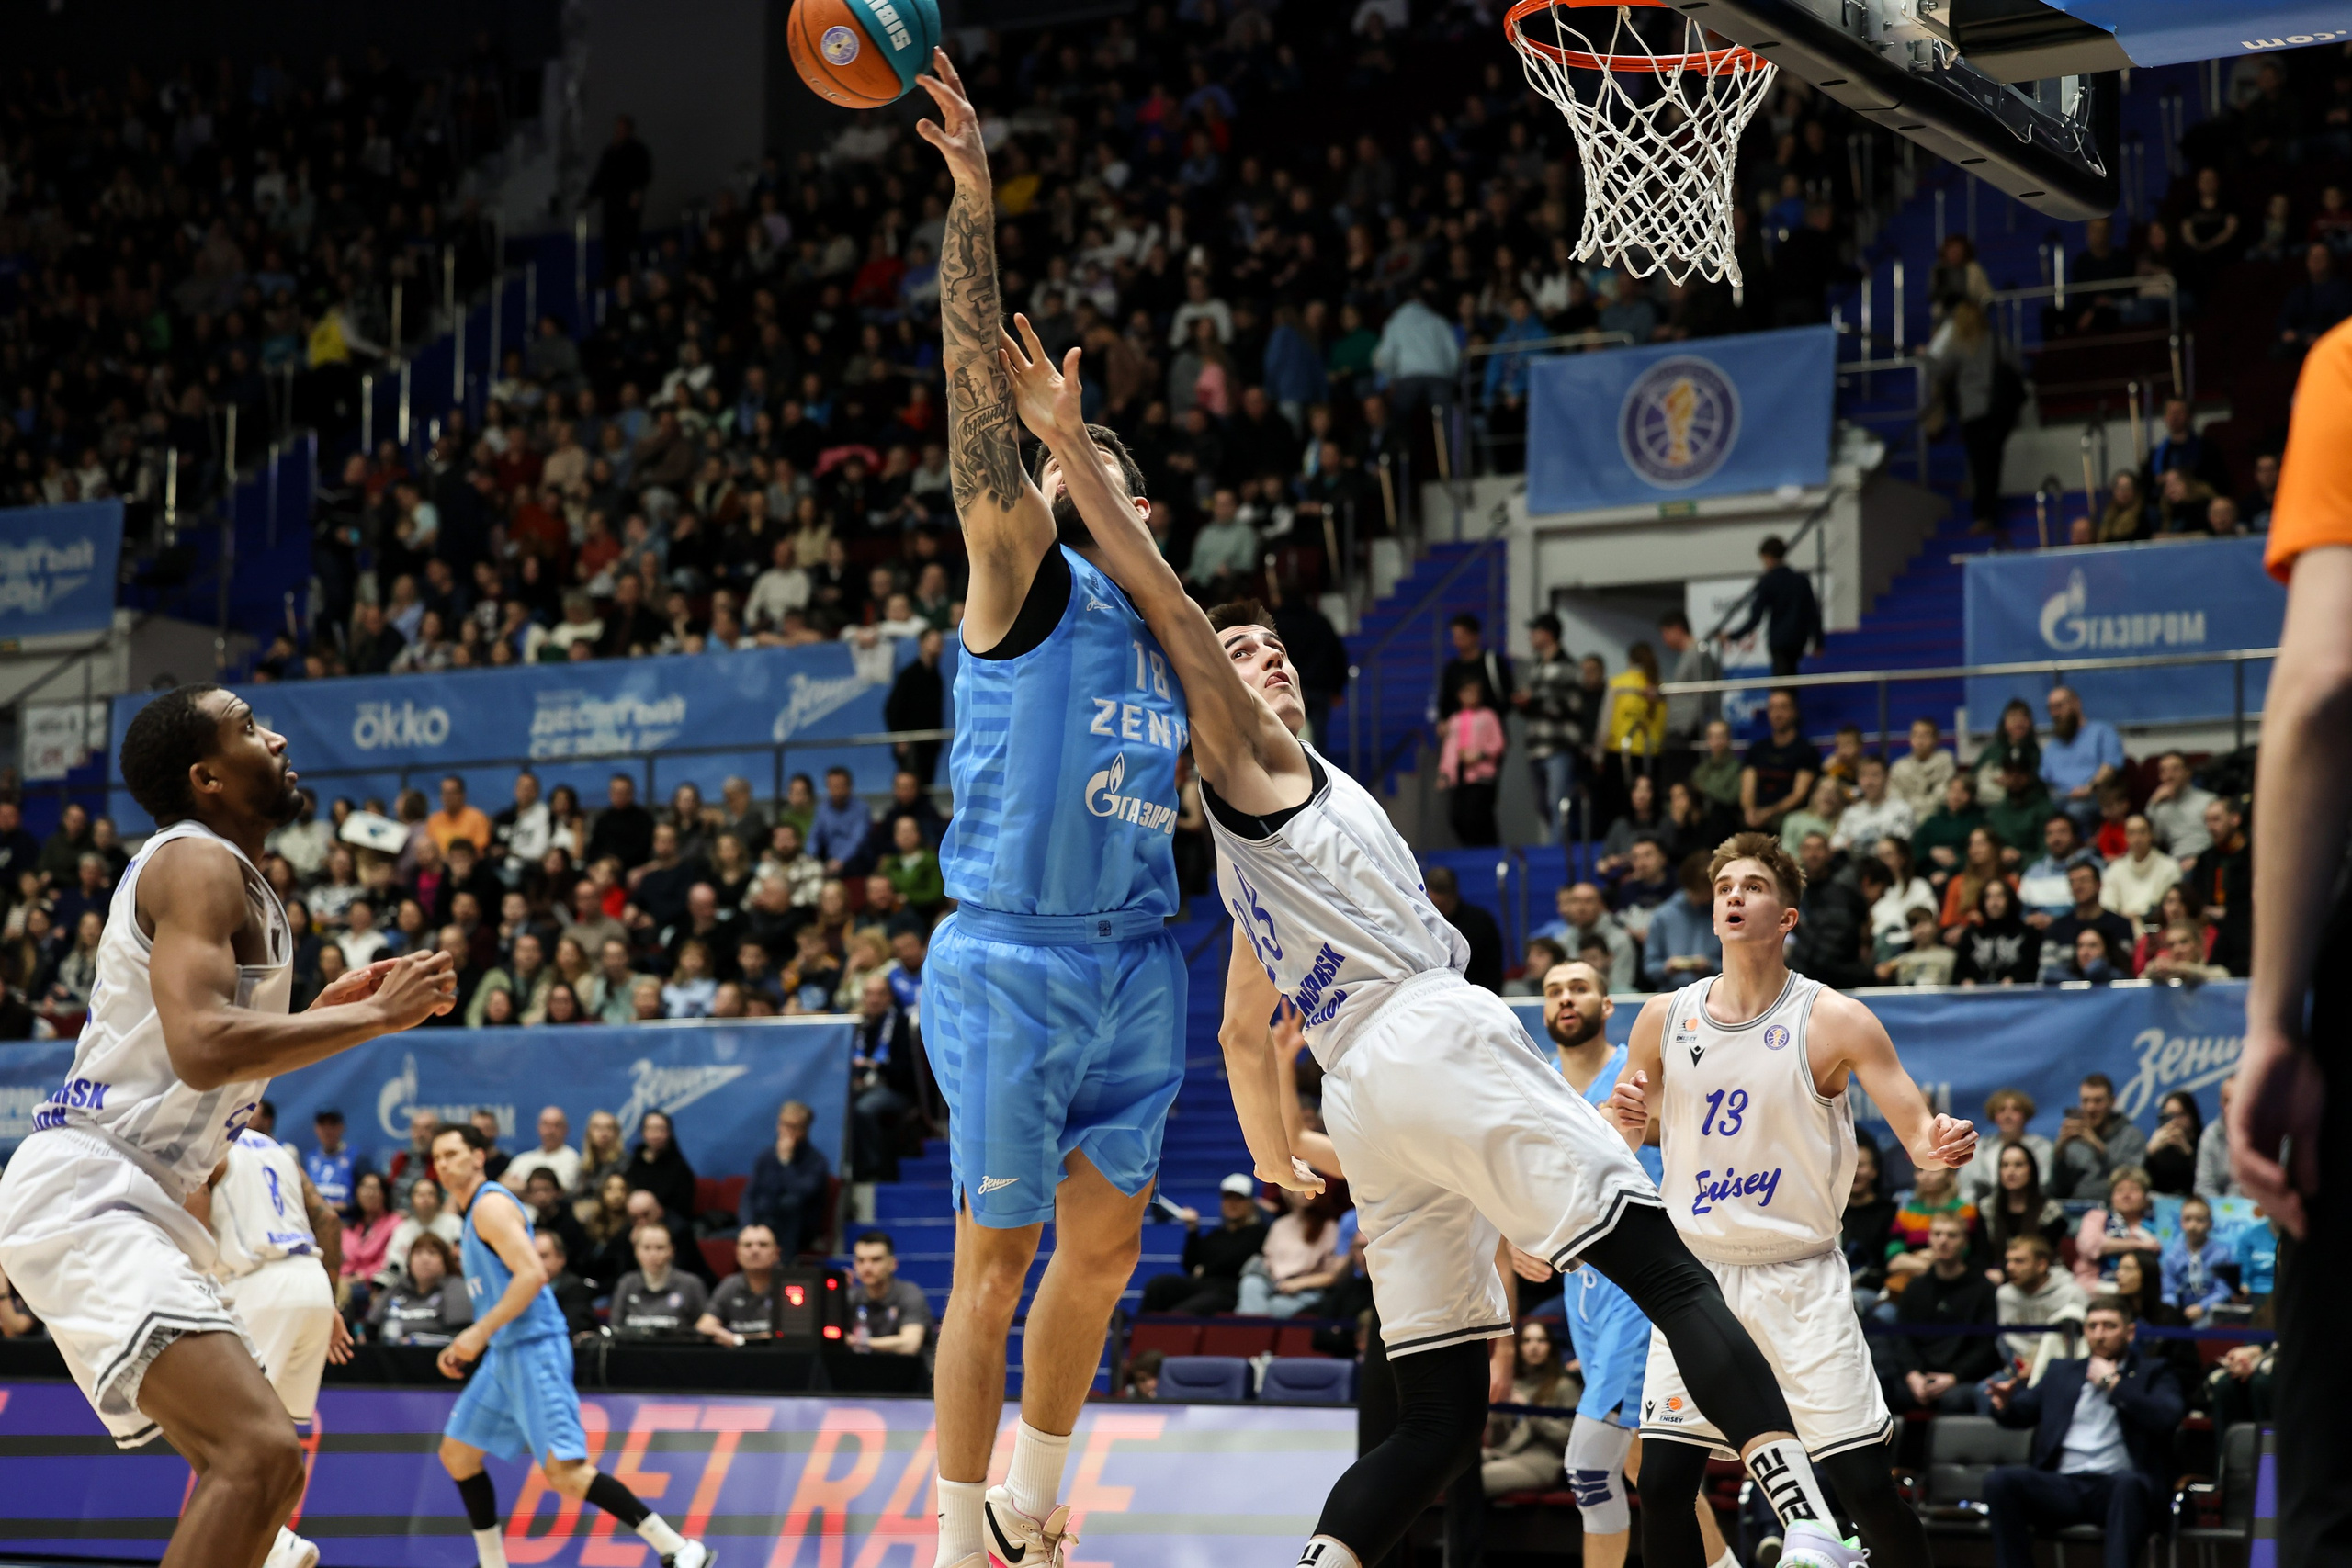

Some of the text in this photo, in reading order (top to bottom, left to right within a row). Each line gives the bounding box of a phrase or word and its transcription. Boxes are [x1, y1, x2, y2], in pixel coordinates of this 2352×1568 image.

[2241, 29, 2347, 50] .com
[1133, 639, 1171, 703] 18
[2113, 1026, 2245, 1120] Зени
[1702, 1089, 1748, 1136] 13
[1691, 1167, 1782, 1216] Enisey
[768, 1407, 1169, 1568] RAE
